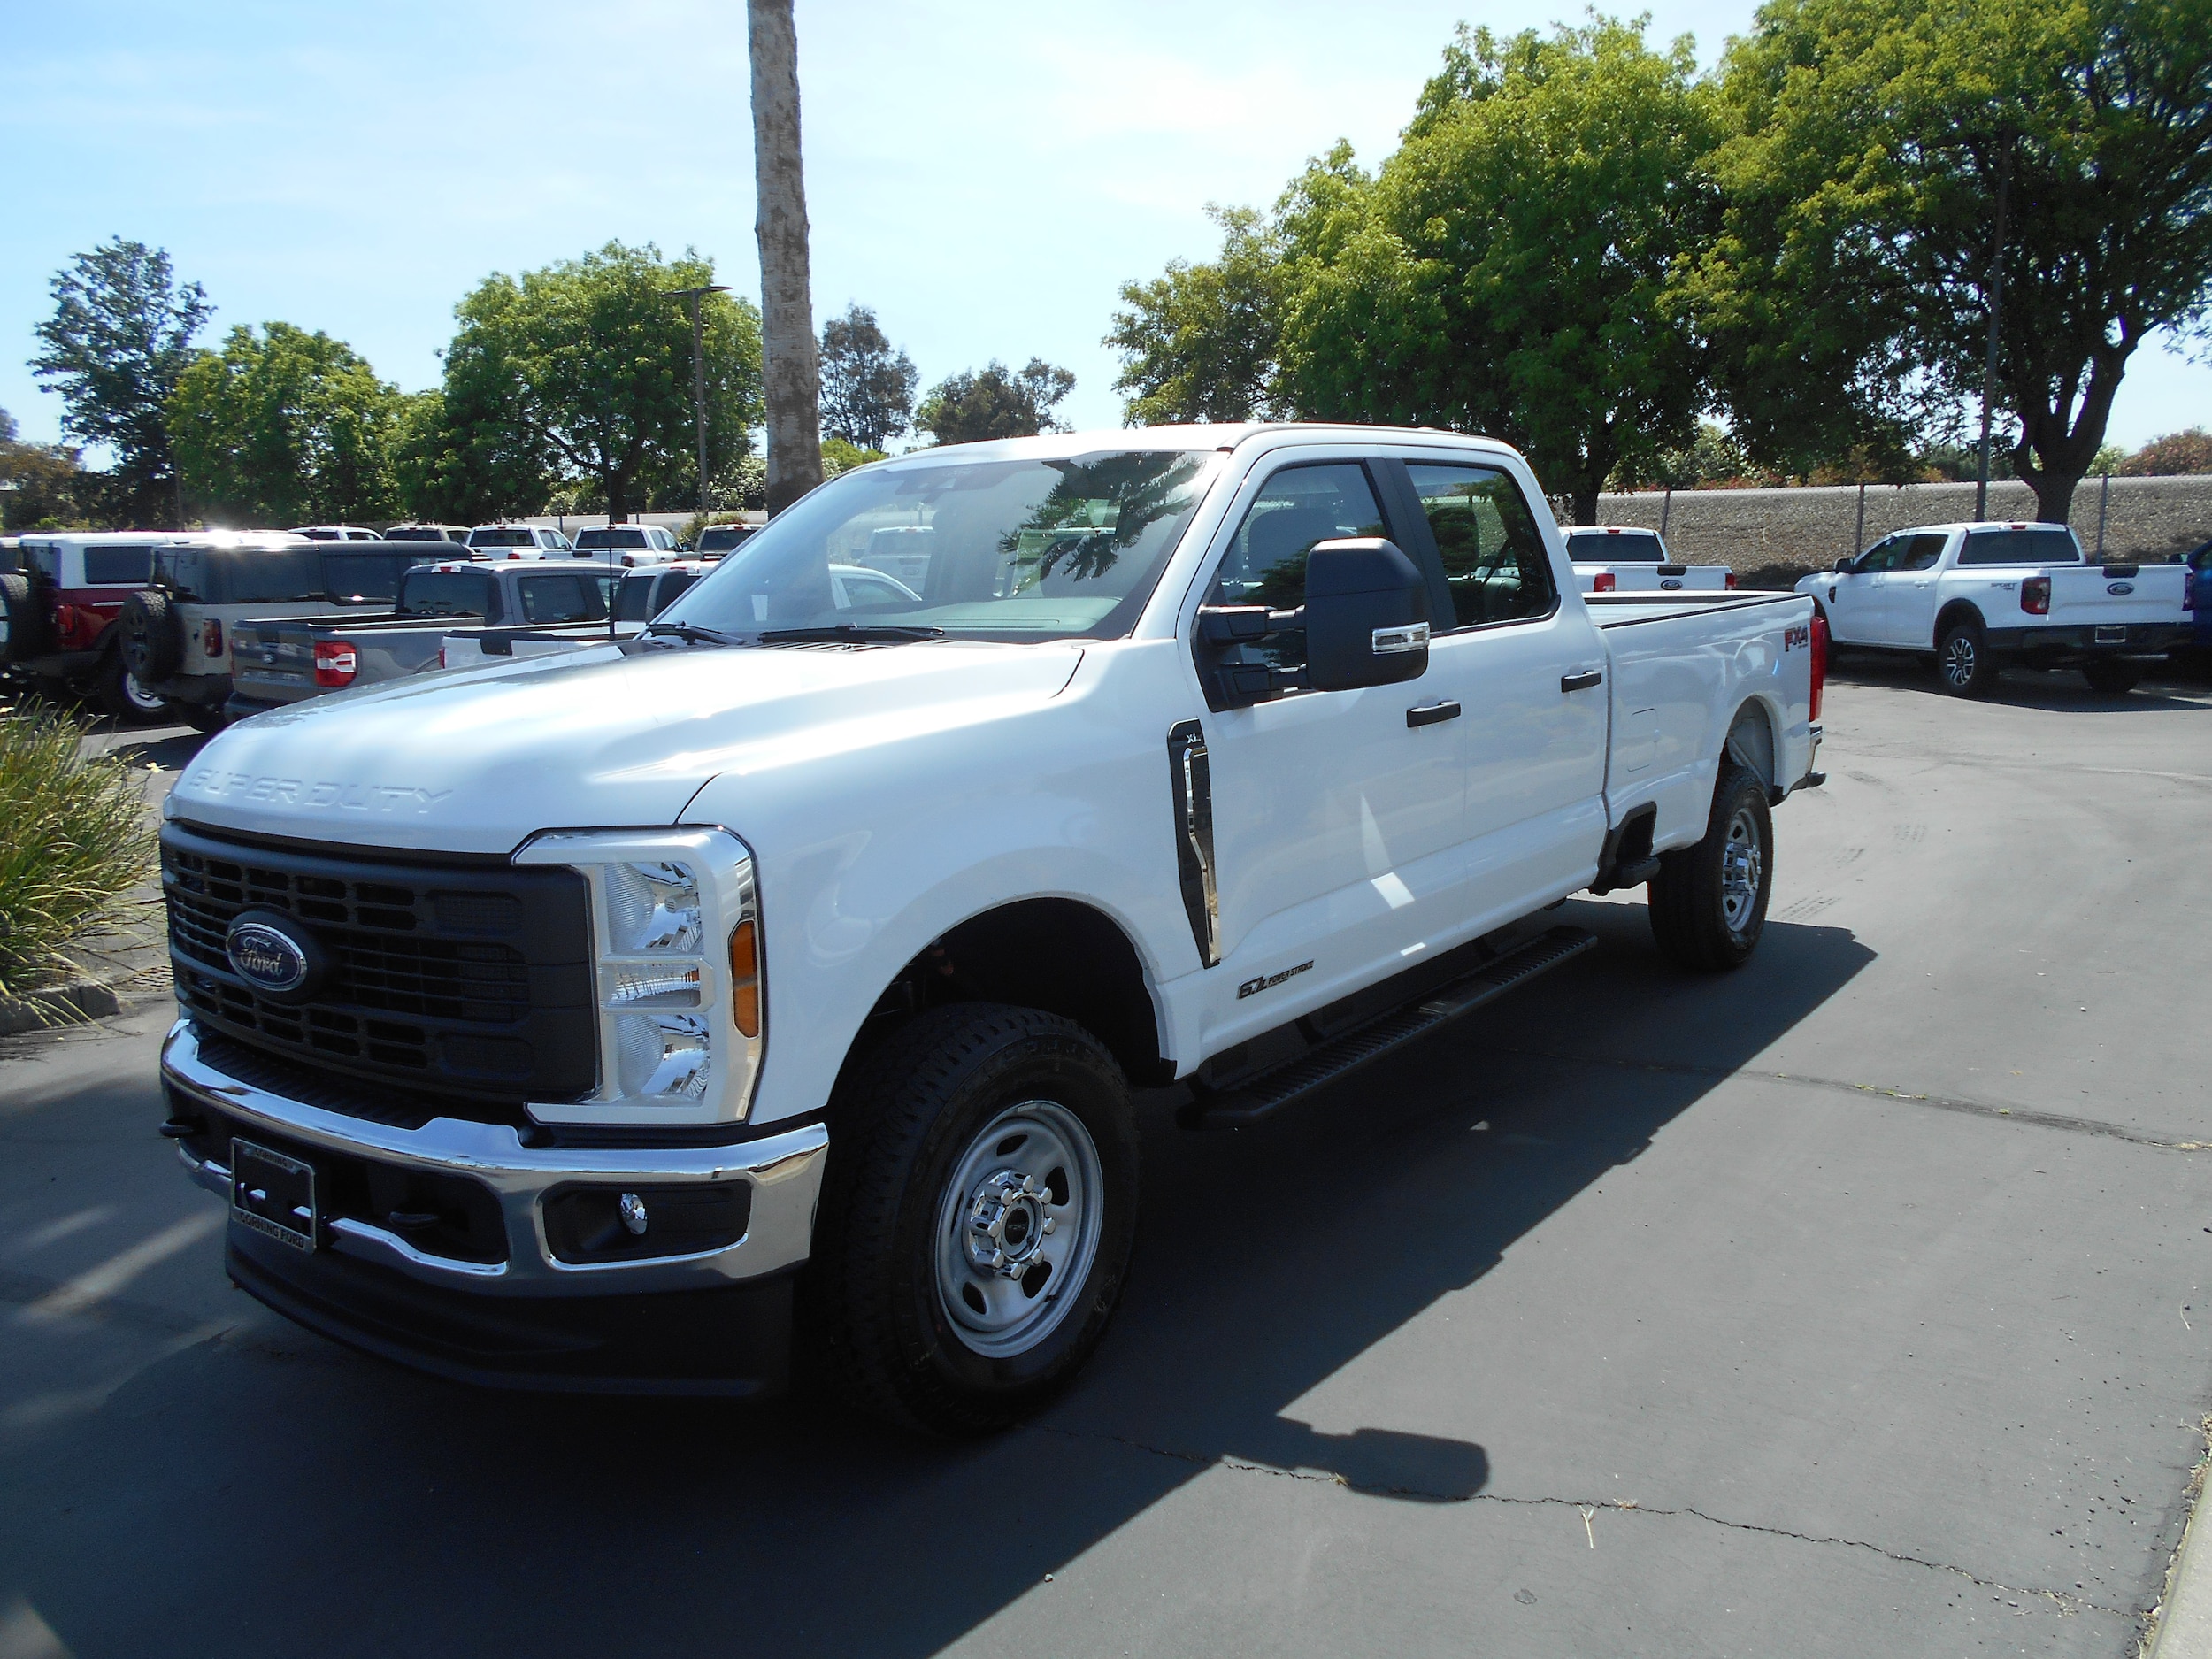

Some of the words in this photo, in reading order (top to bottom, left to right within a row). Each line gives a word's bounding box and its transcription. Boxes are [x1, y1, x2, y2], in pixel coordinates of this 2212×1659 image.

[1784, 626, 1809, 653] FX4
[1186, 733, 1202, 744] XL
[188, 768, 303, 804] SUPER
[303, 782, 454, 814] DUTY
[240, 936, 284, 975] Ford
